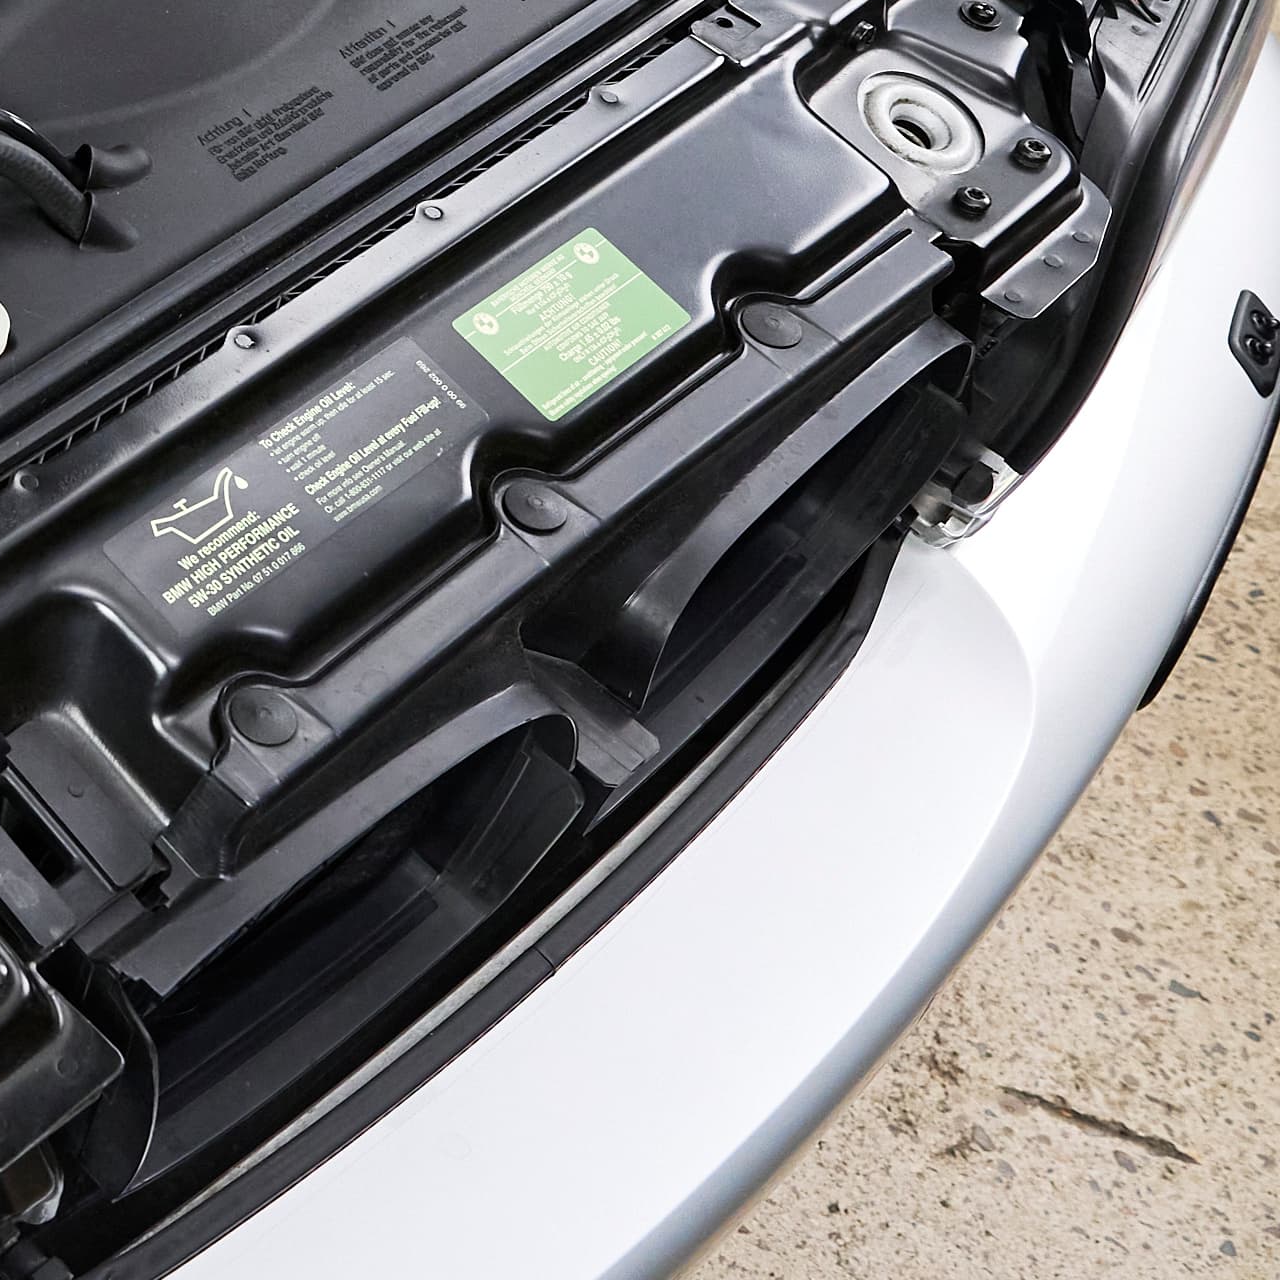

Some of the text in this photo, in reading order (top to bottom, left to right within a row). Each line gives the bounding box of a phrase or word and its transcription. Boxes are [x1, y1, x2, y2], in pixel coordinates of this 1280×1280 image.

[538, 293, 575, 320] ACHTUNG!
[558, 343, 583, 361] Charge
[588, 339, 623, 365] CAUTION!
[259, 380, 355, 449] To Check Engine Oil Level:
[281, 434, 302, 450] engine
[299, 423, 316, 436] warm
[324, 408, 338, 419] then
[374, 376, 383, 384] 15
[293, 439, 314, 456] engine
[297, 465, 315, 479] check
[313, 459, 322, 467] oil
[304, 396, 442, 495] Check Engine Oil Level at every Fuel Fill-up!
[316, 494, 329, 505] For
[326, 484, 343, 498] more
[350, 469, 363, 480] see
[361, 453, 385, 472] Owner's
[344, 467, 386, 499] 1-800-831-1117
[162, 502, 299, 604] BMW HIGH PERFORMANCE
[178, 508, 260, 570] We recommend:
[188, 523, 299, 608] 5W-30 SYNTHETIC OIL
[207, 598, 228, 616] BMW
[226, 587, 243, 602] Part
[252, 572, 264, 583] 07
